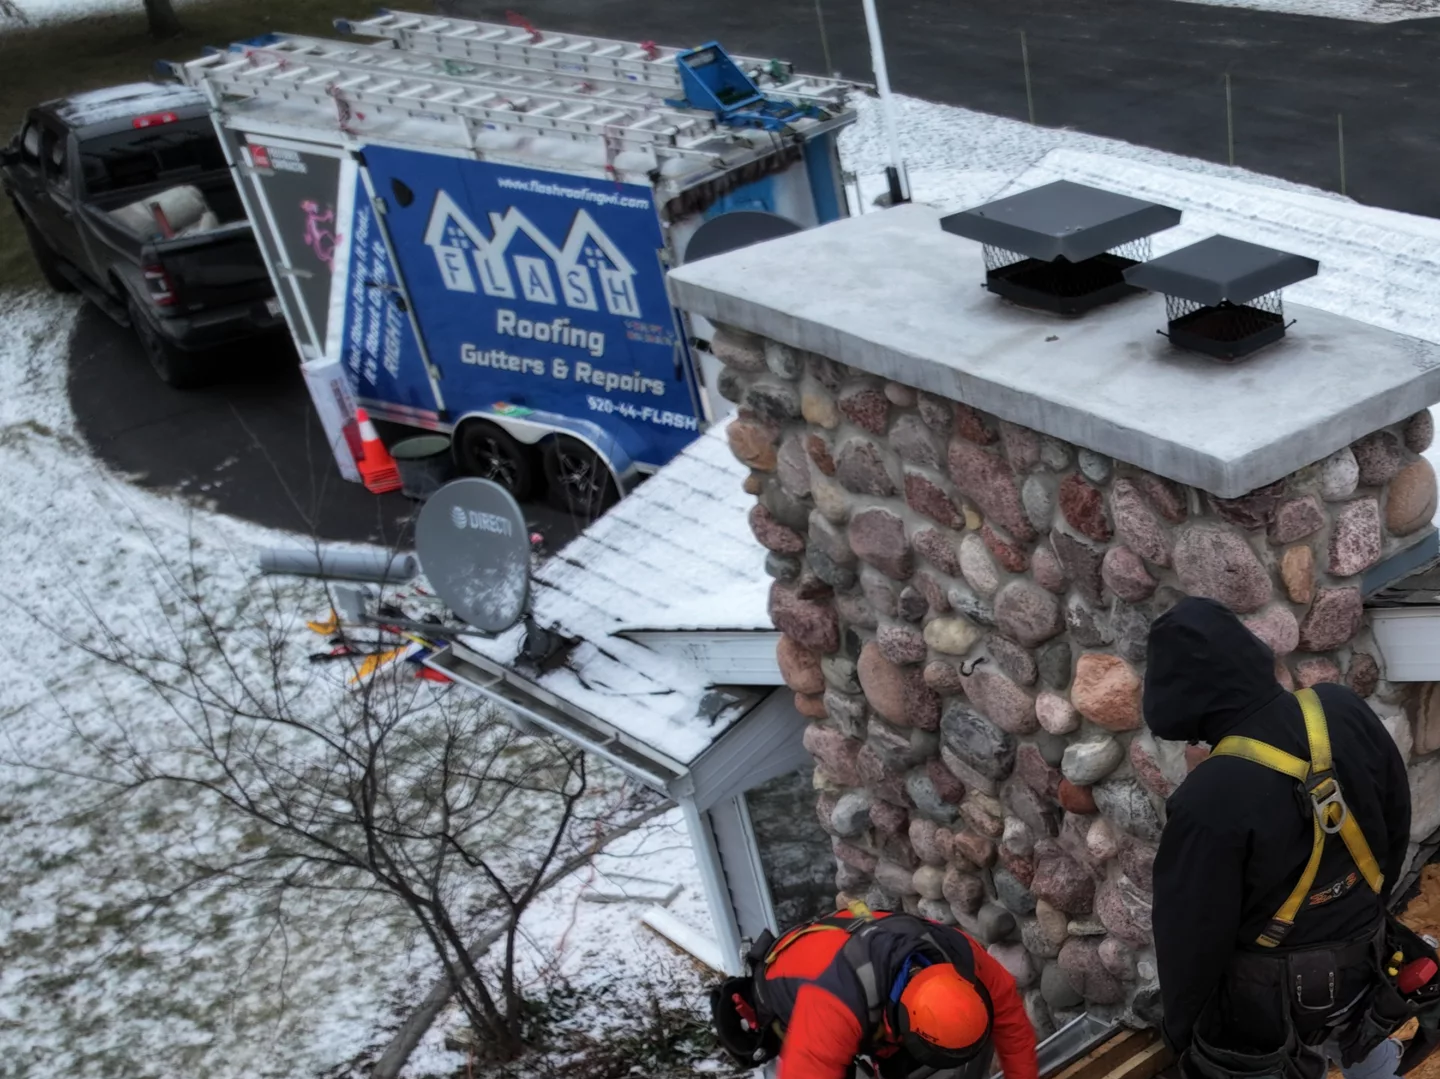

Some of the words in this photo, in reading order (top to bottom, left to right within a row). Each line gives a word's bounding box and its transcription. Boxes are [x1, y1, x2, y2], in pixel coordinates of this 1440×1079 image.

[497, 177, 650, 210] www.flashroofingwi.com
[352, 260, 368, 303] Doing
[442, 250, 636, 314] FLASH
[350, 302, 363, 344] About
[365, 306, 381, 359] About
[496, 308, 605, 357] Roofing
[460, 342, 546, 376] Gutters
[552, 357, 569, 380] &
[574, 360, 667, 396] Repairs
